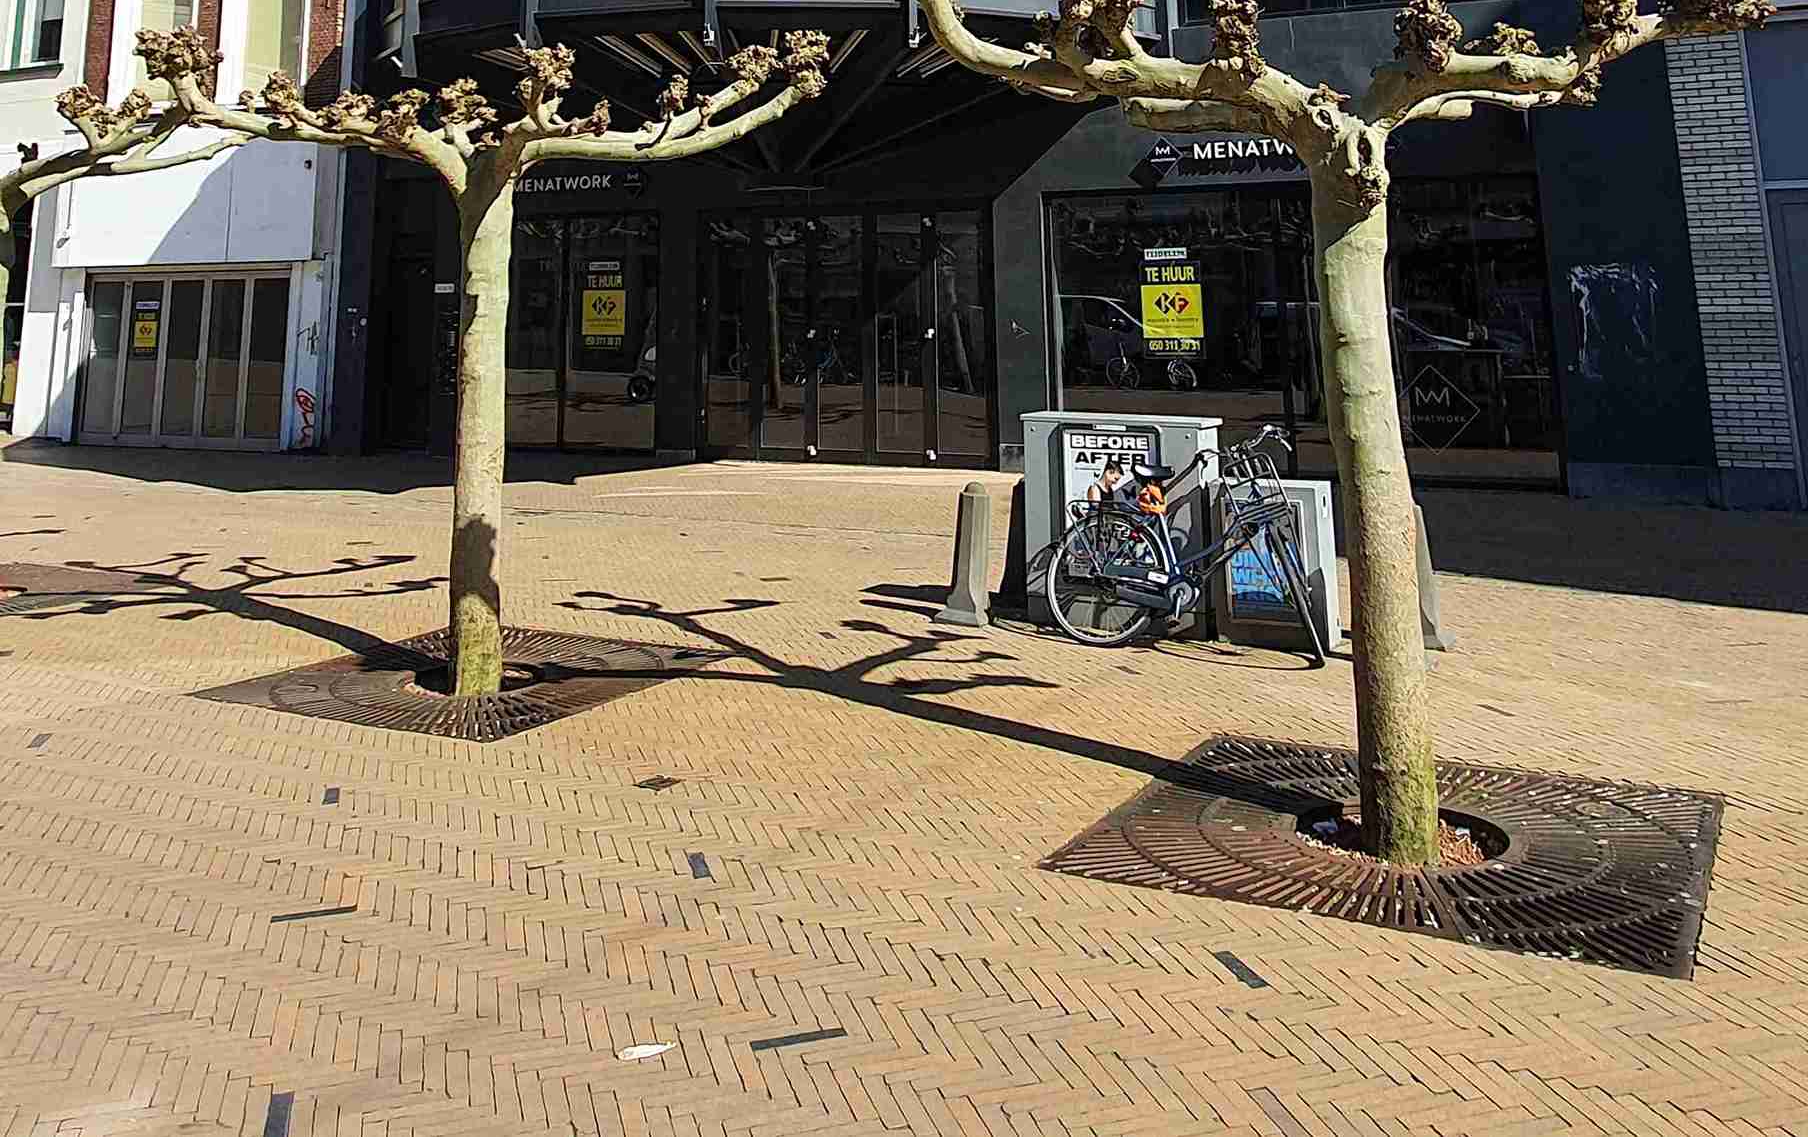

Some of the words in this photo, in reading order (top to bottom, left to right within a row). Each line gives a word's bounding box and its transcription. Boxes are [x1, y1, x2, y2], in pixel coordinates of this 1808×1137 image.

[1193, 138, 1294, 160] MENATW
[514, 174, 613, 193] MENATWORK
[1145, 266, 1160, 282] TE
[1161, 265, 1196, 282] HUUR
[1071, 435, 1149, 450] BEFORE
[1075, 451, 1147, 465] AFTER
